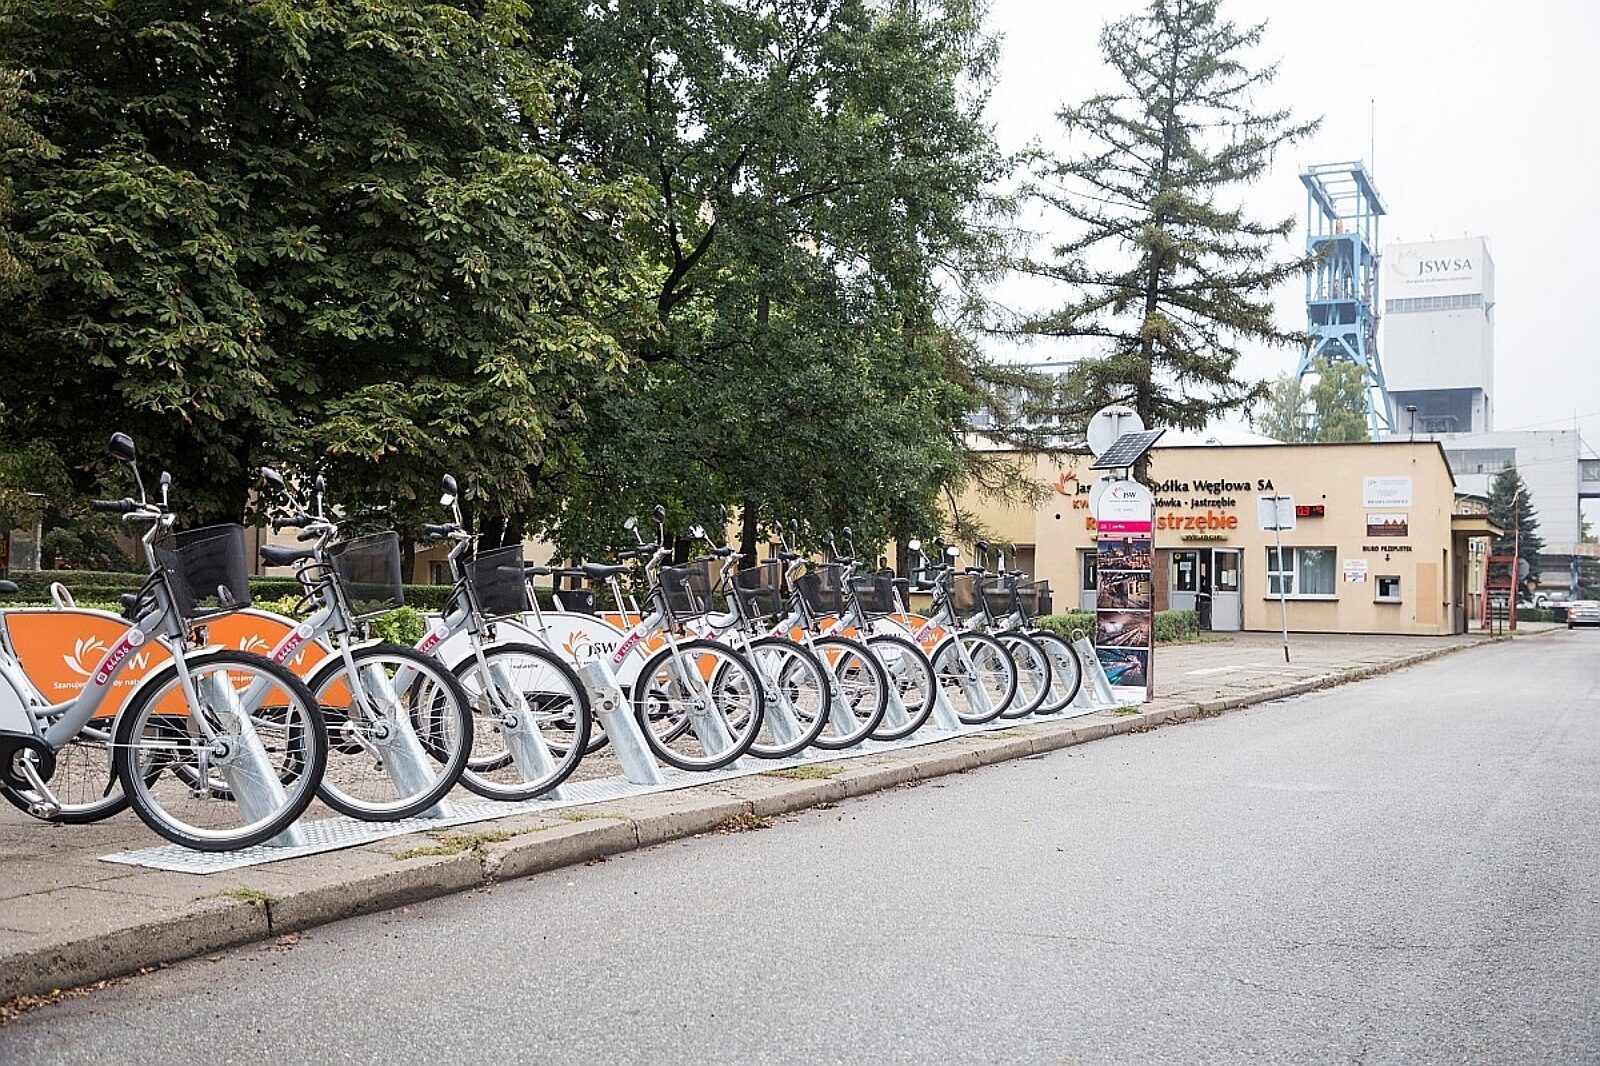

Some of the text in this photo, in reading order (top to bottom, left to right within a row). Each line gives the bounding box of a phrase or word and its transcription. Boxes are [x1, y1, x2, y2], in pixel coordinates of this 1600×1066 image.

[1419, 258, 1472, 275] JSW SA
[1193, 479, 1251, 495] Węglowa
[1257, 479, 1274, 491] SA
[1153, 498, 1181, 507] iówka
[1190, 497, 1236, 509] Jastrzębie
[1157, 510, 1238, 534] strzębie
[588, 642, 617, 657] JSW
[106, 645, 129, 671] 64436
